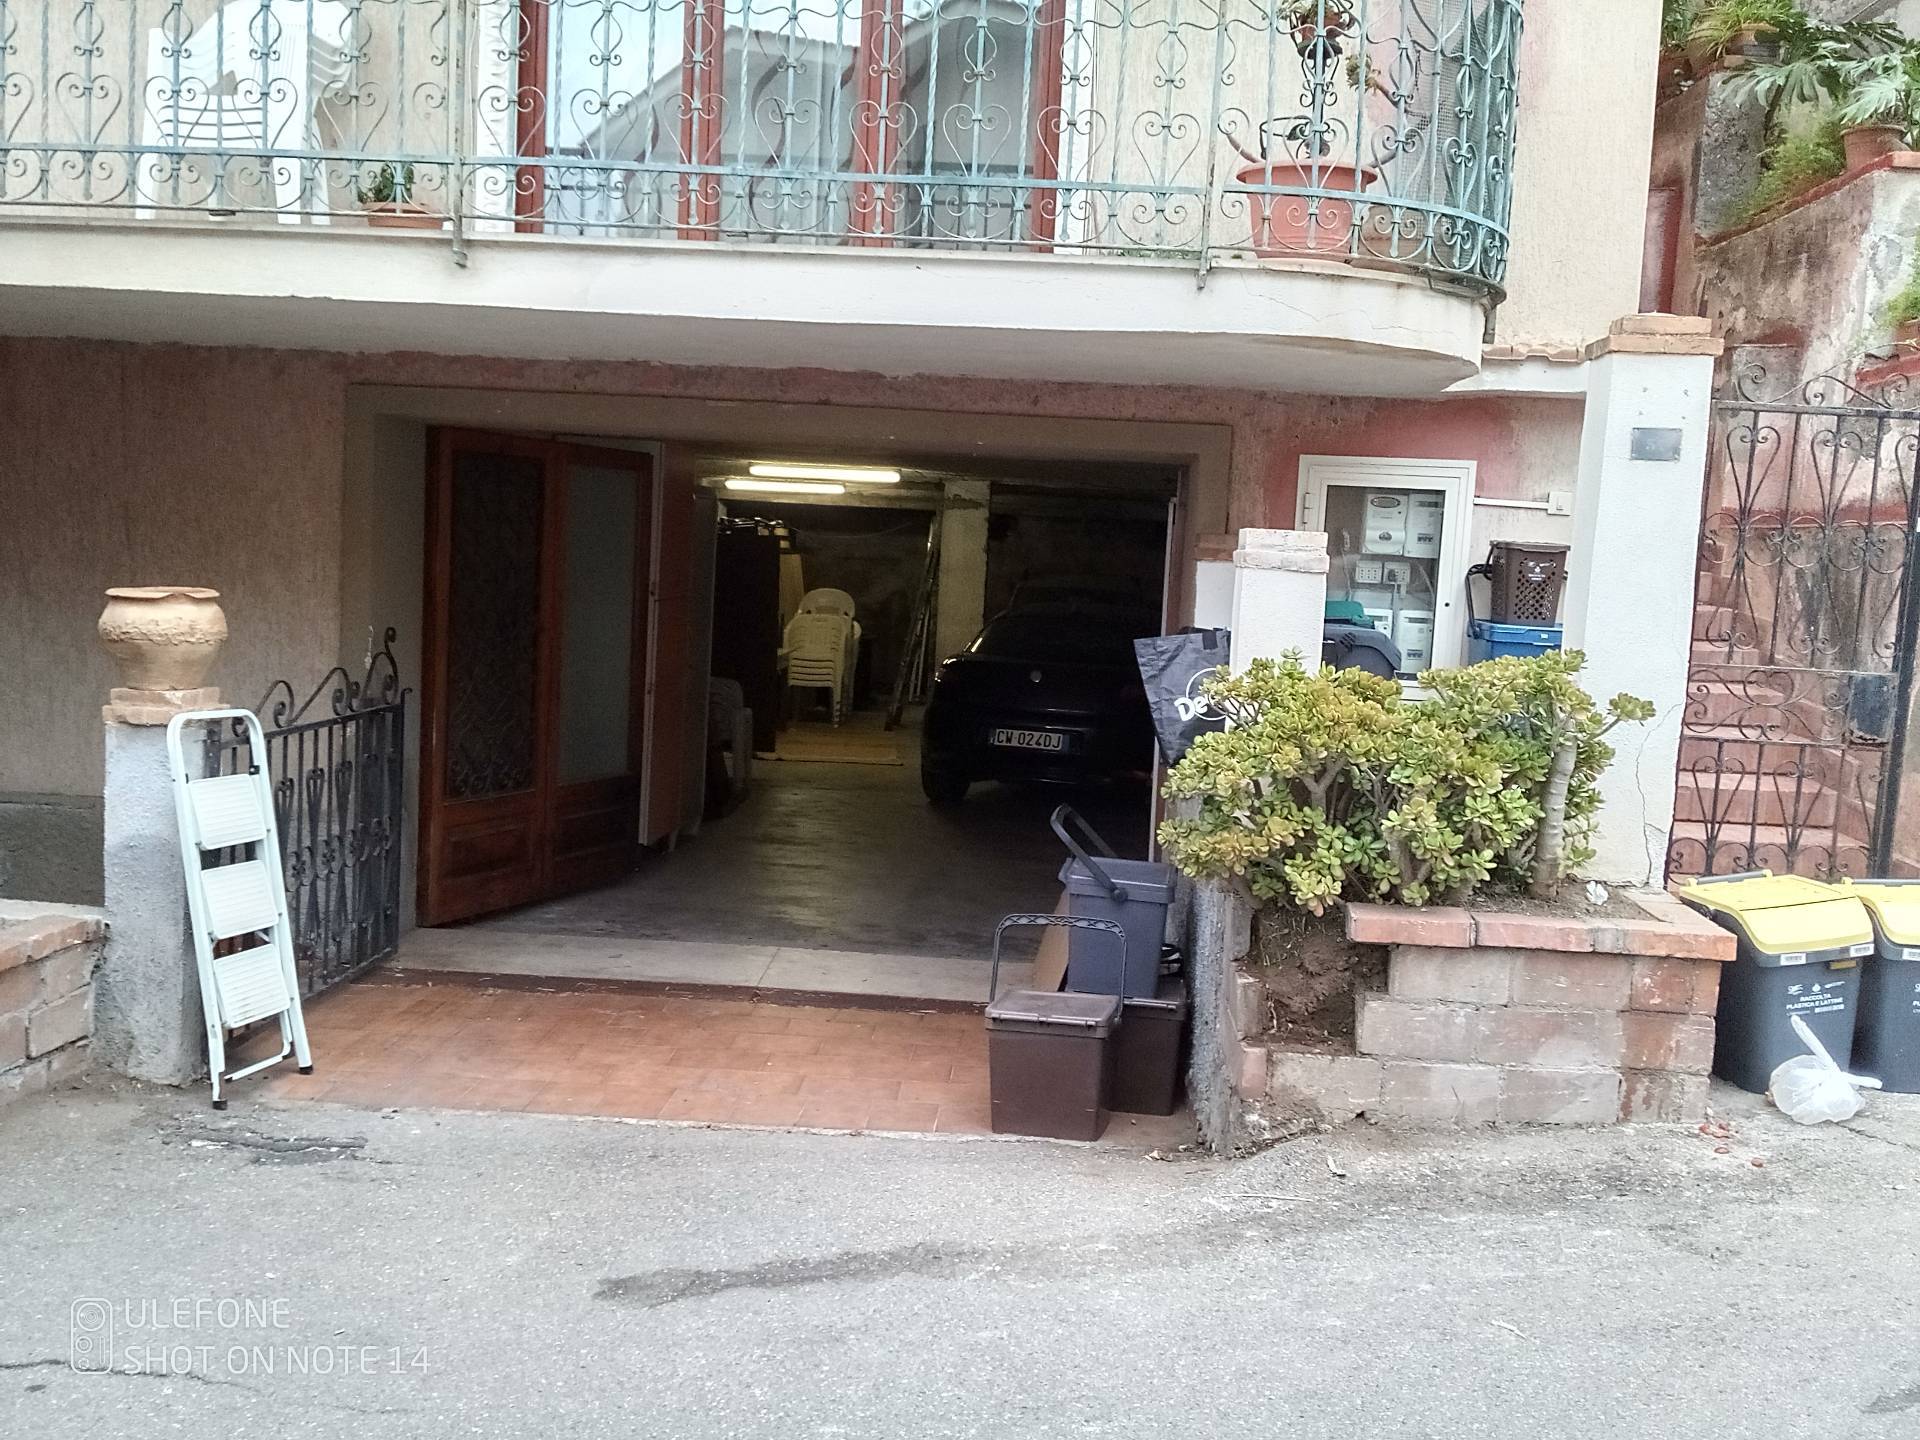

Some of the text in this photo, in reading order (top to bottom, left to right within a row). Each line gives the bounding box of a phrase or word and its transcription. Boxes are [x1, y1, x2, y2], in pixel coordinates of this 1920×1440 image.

[997, 730, 1061, 749] CW 024DJ
[1800, 993, 1832, 1002] RACCOLTA
[1786, 1001, 1815, 1010] PLASTICA
